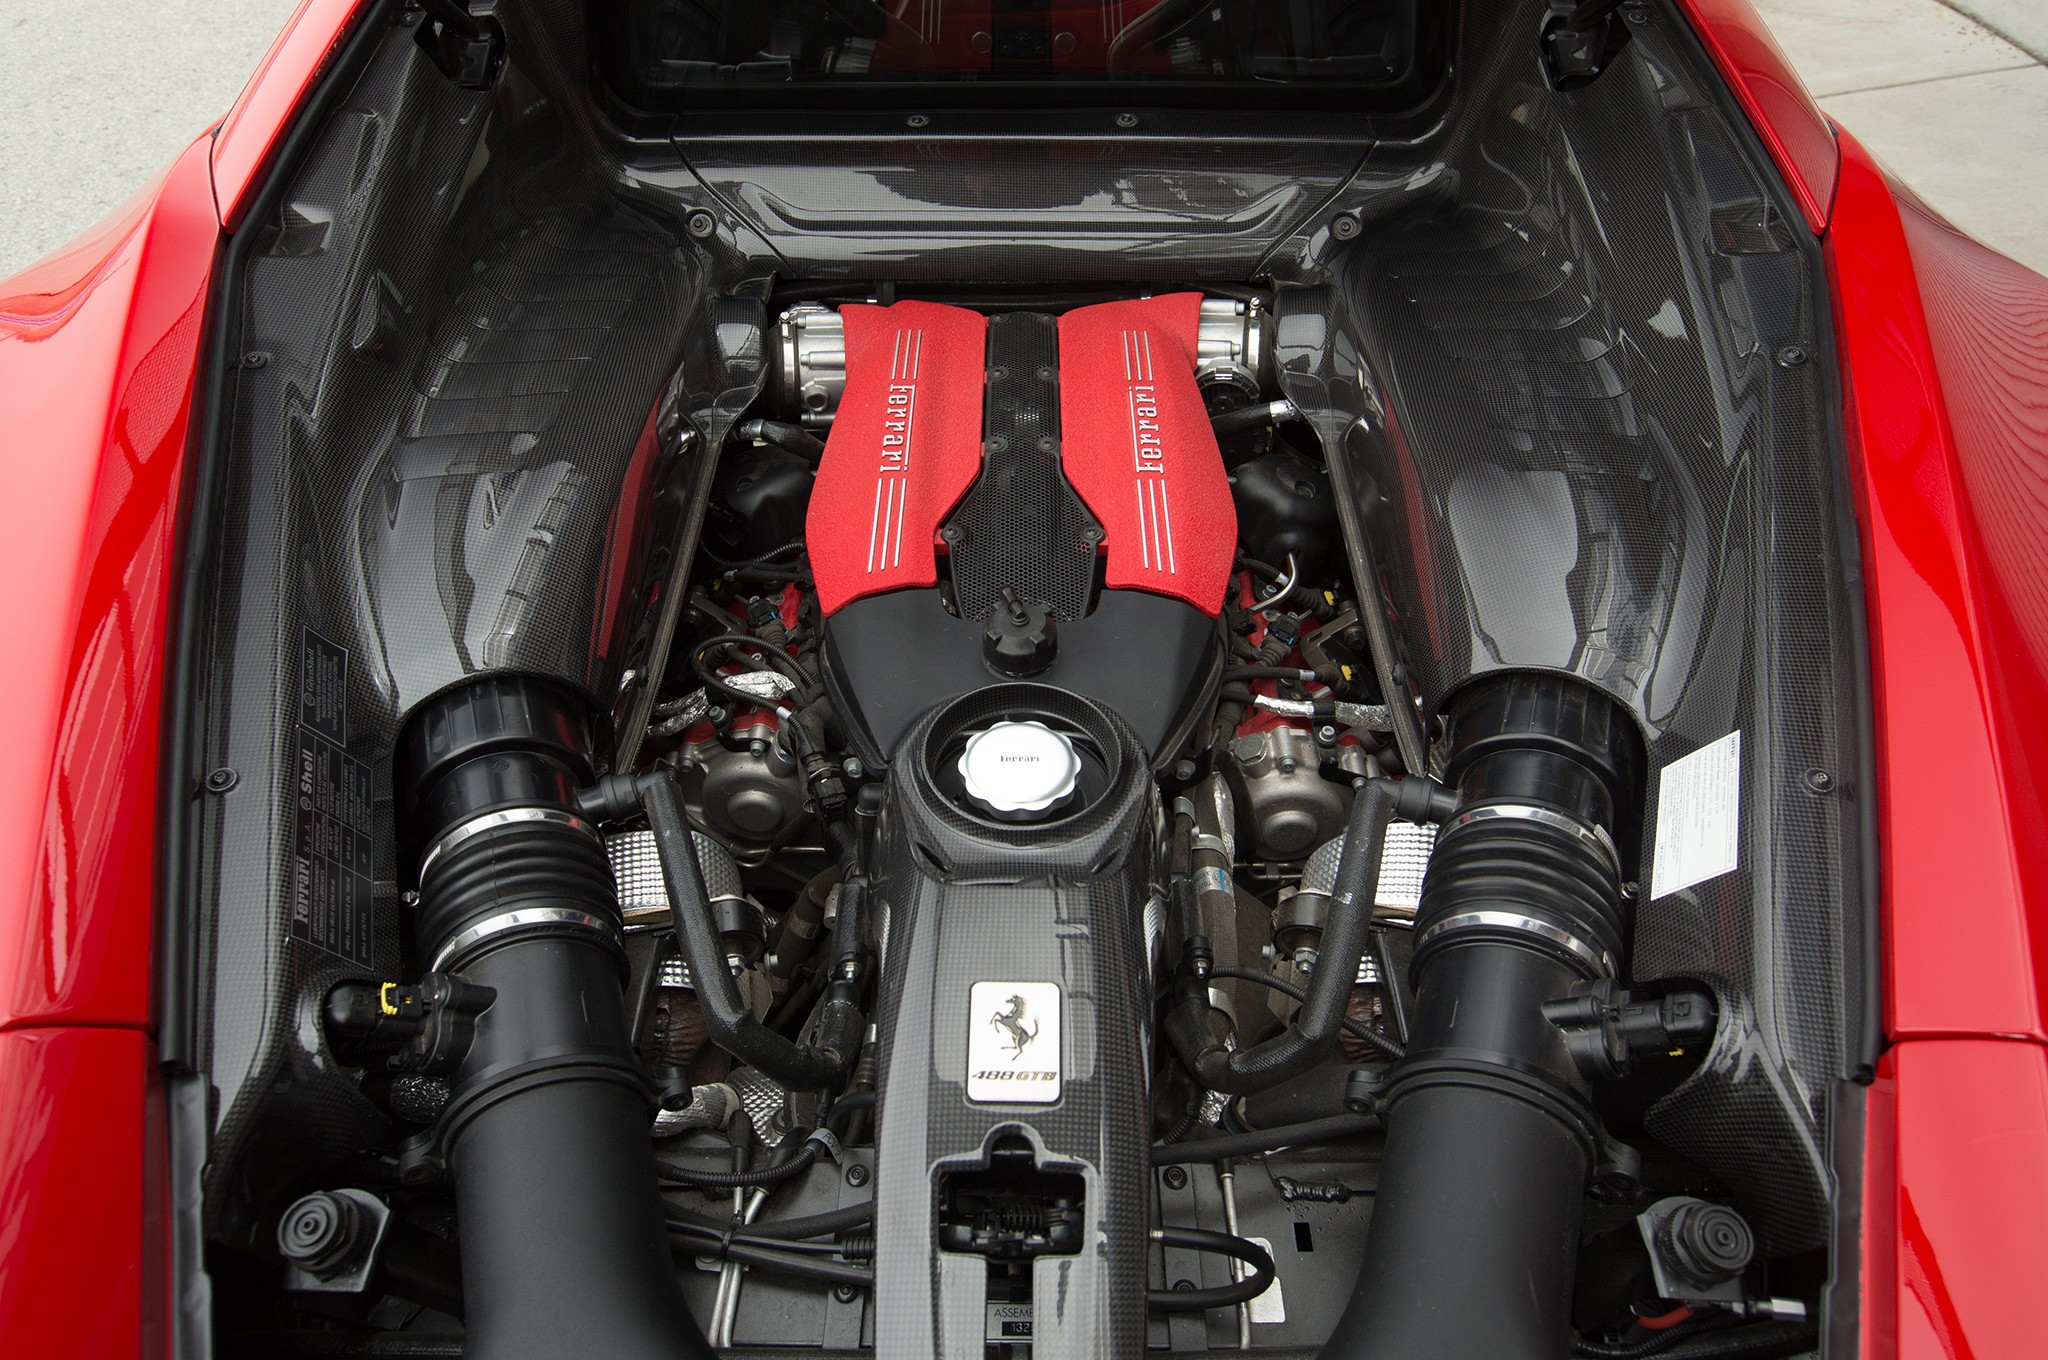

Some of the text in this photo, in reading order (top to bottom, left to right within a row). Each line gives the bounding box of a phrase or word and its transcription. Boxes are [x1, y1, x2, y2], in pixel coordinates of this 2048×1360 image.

[880, 384, 916, 473] Ferrari
[1128, 385, 1164, 473] Ferrari
[301, 748, 312, 794] Shell
[294, 854, 310, 924] Ferrari
[972, 1070, 1057, 1080] 488 GTB
[822, 1132, 839, 1149] PCV
[1012, 1322, 1033, 1332] 132
